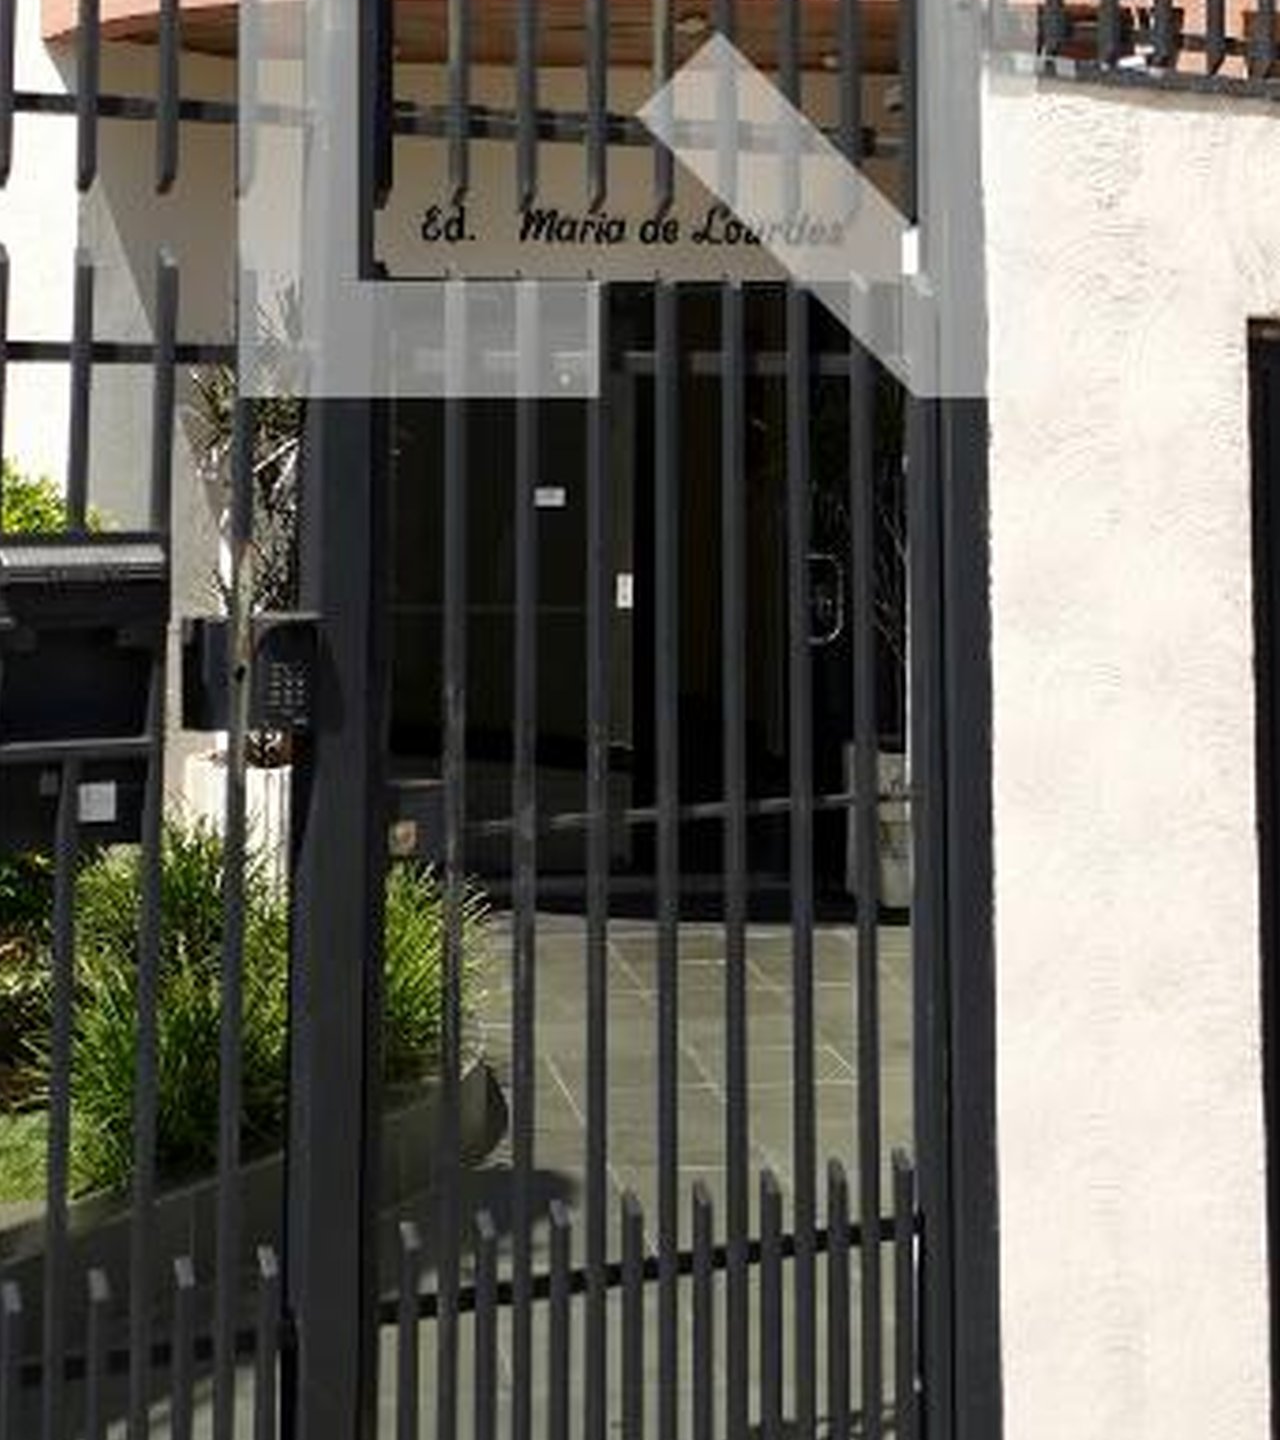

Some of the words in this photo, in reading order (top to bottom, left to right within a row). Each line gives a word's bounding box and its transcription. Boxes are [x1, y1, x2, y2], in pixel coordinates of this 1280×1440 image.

[421, 205, 476, 243] Ed.
[518, 206, 626, 243] Maria
[638, 207, 679, 244] de
[690, 203, 846, 246] Lourdes
